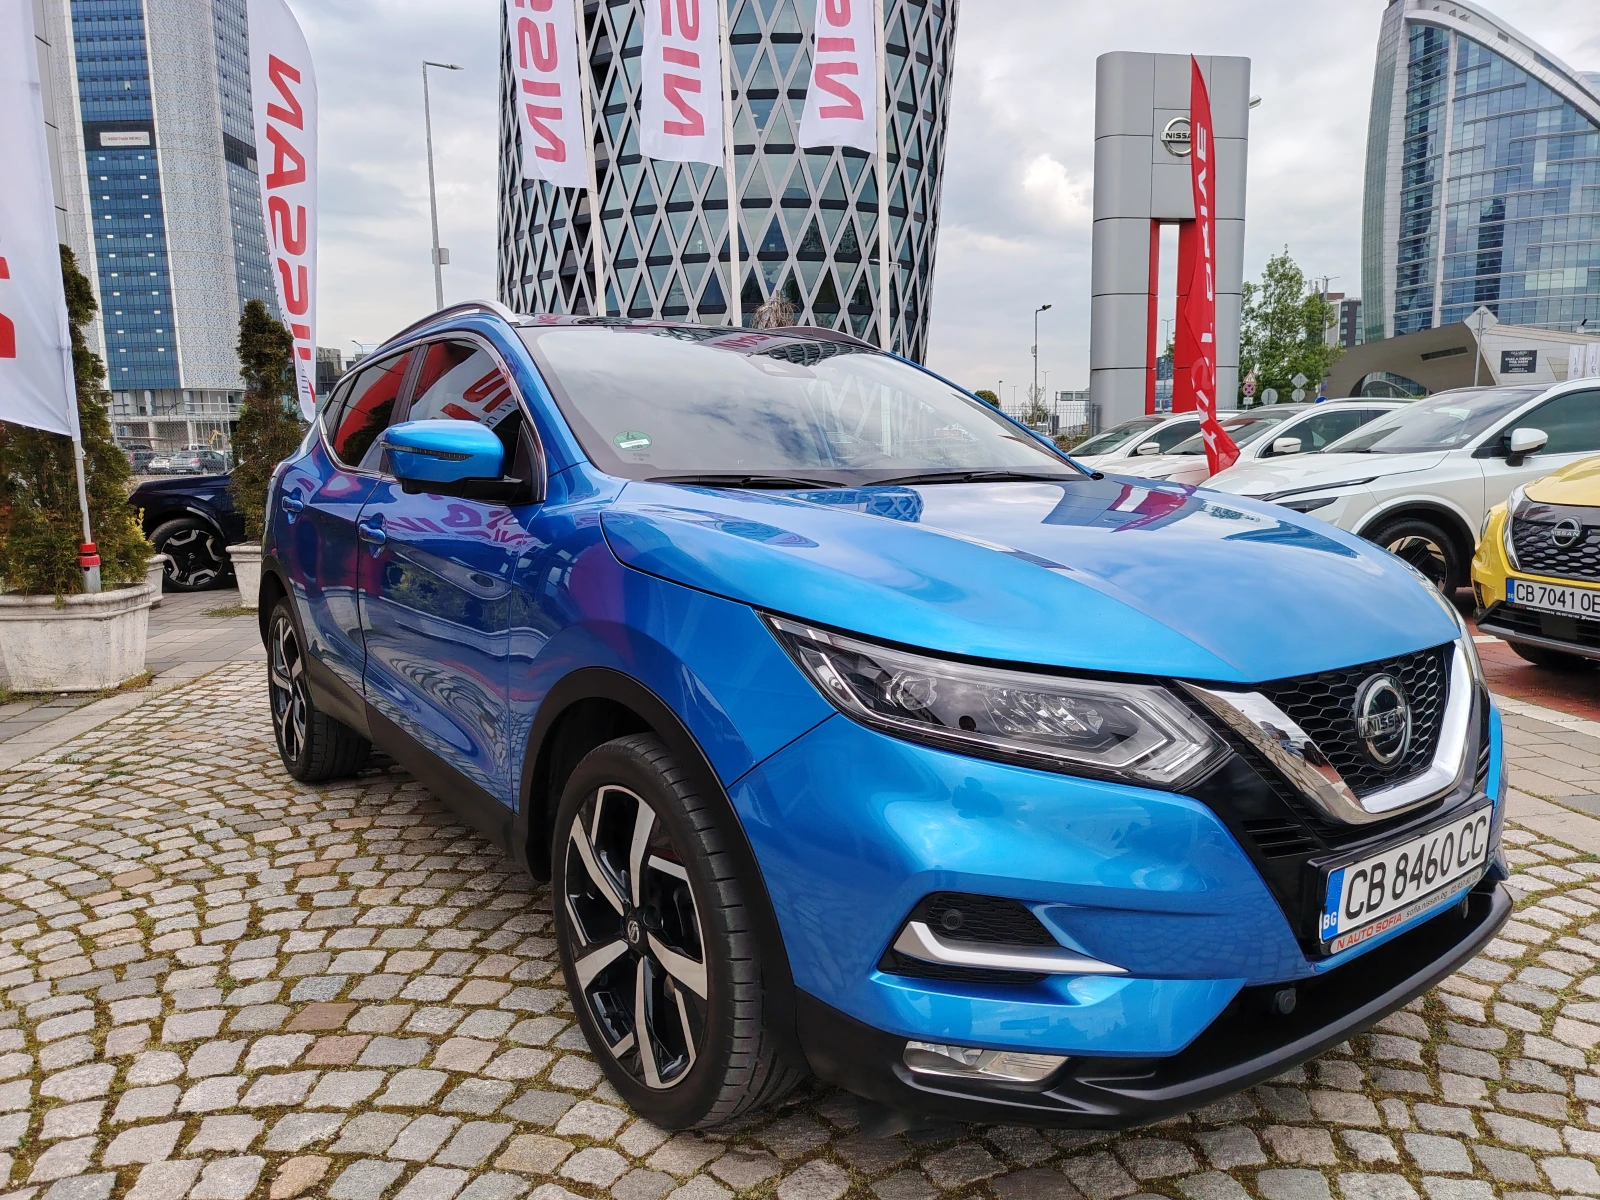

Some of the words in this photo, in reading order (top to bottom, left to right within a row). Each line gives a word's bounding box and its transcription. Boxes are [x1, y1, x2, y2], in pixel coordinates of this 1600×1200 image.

[1516, 583, 1535, 603] CB
[1538, 586, 1575, 610] 7041
[1363, 711, 1406, 736] NISSAN
[1345, 861, 1387, 920] CB
[1391, 831, 1454, 901] 8460
[1457, 815, 1487, 868] CC
[1323, 911, 1338, 931] BG
[1336, 938, 1346, 951] N
[1346, 926, 1374, 946] AUTO
[1375, 913, 1403, 933] SOFIA
